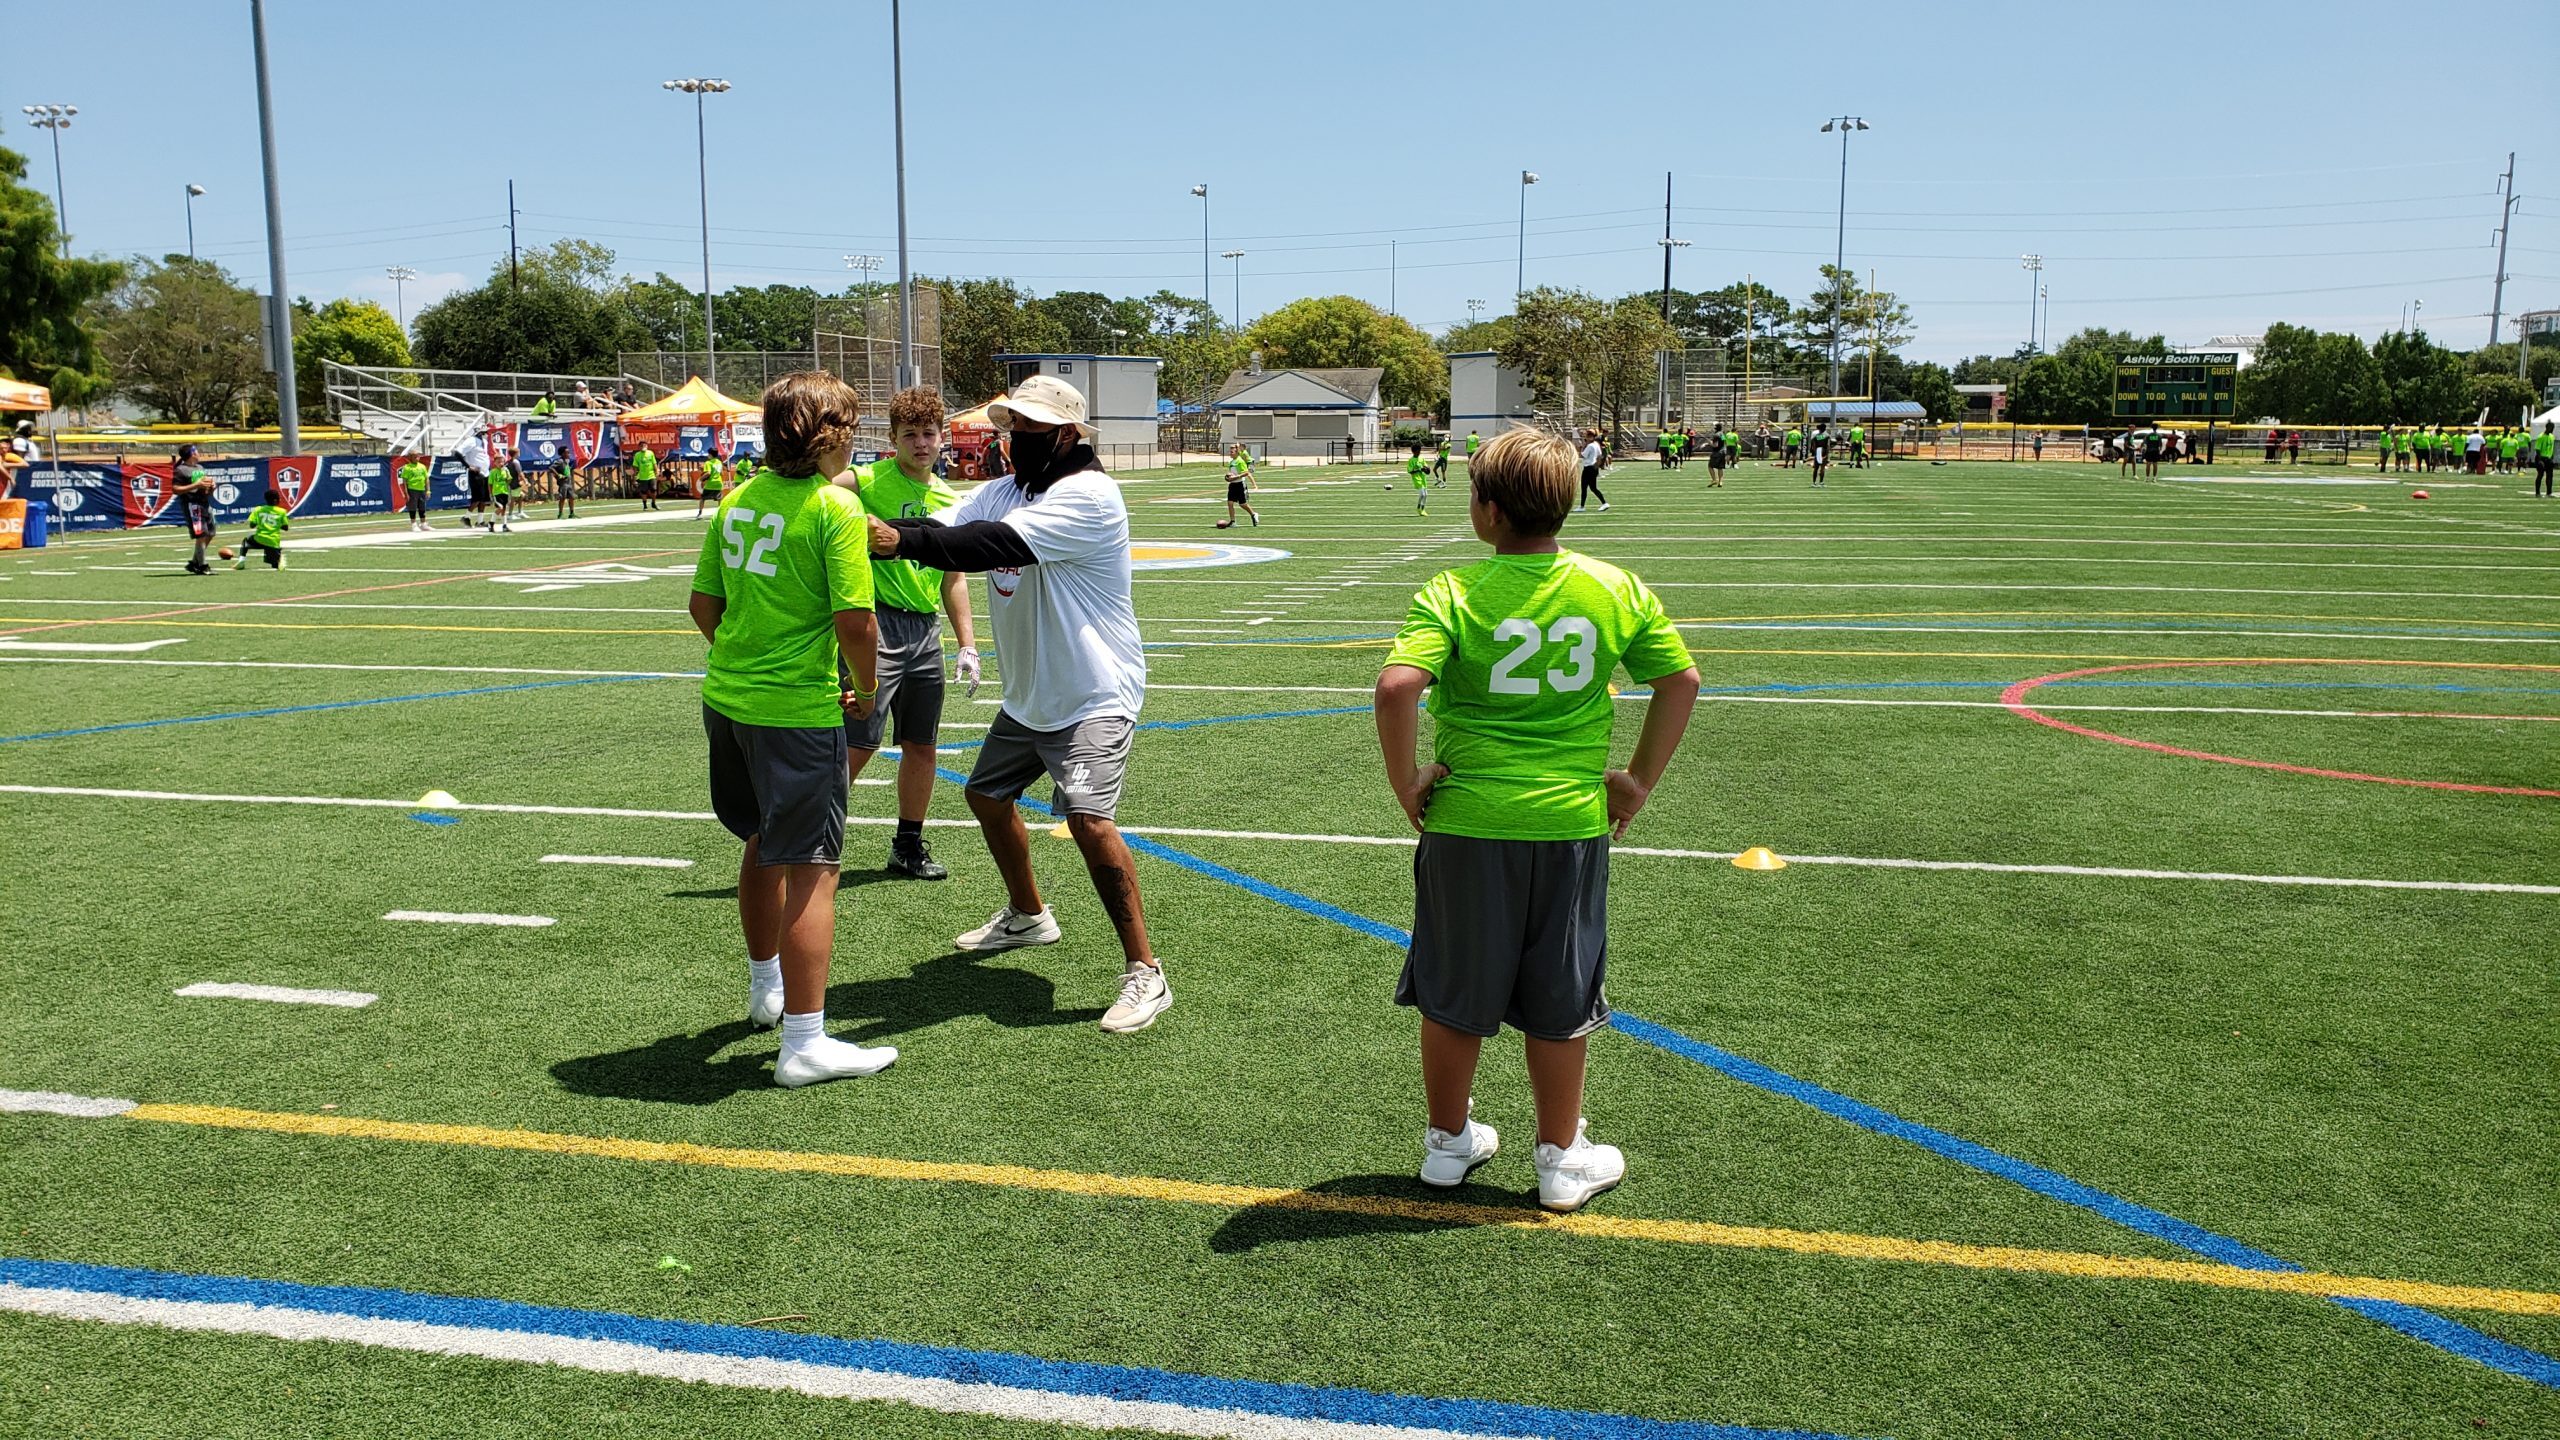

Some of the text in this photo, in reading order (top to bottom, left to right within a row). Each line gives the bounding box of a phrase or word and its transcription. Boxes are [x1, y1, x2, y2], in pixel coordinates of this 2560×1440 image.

[2122, 354, 2233, 365] Ashley Booth Field
[2118, 367, 2141, 376] HOME
[2211, 367, 2235, 375] GUEST
[2117, 392, 2139, 401] DOWN
[2145, 392, 2166, 401] TO GO
[2181, 392, 2208, 401] BALL ON
[2214, 392, 2229, 401] QTR
[964, 463, 975, 476] G
[258, 513, 277, 526] 75
[722, 507, 785, 577] 52
[1488, 616, 1597, 695] 23
[1065, 785, 1094, 794] FOOTBALL
